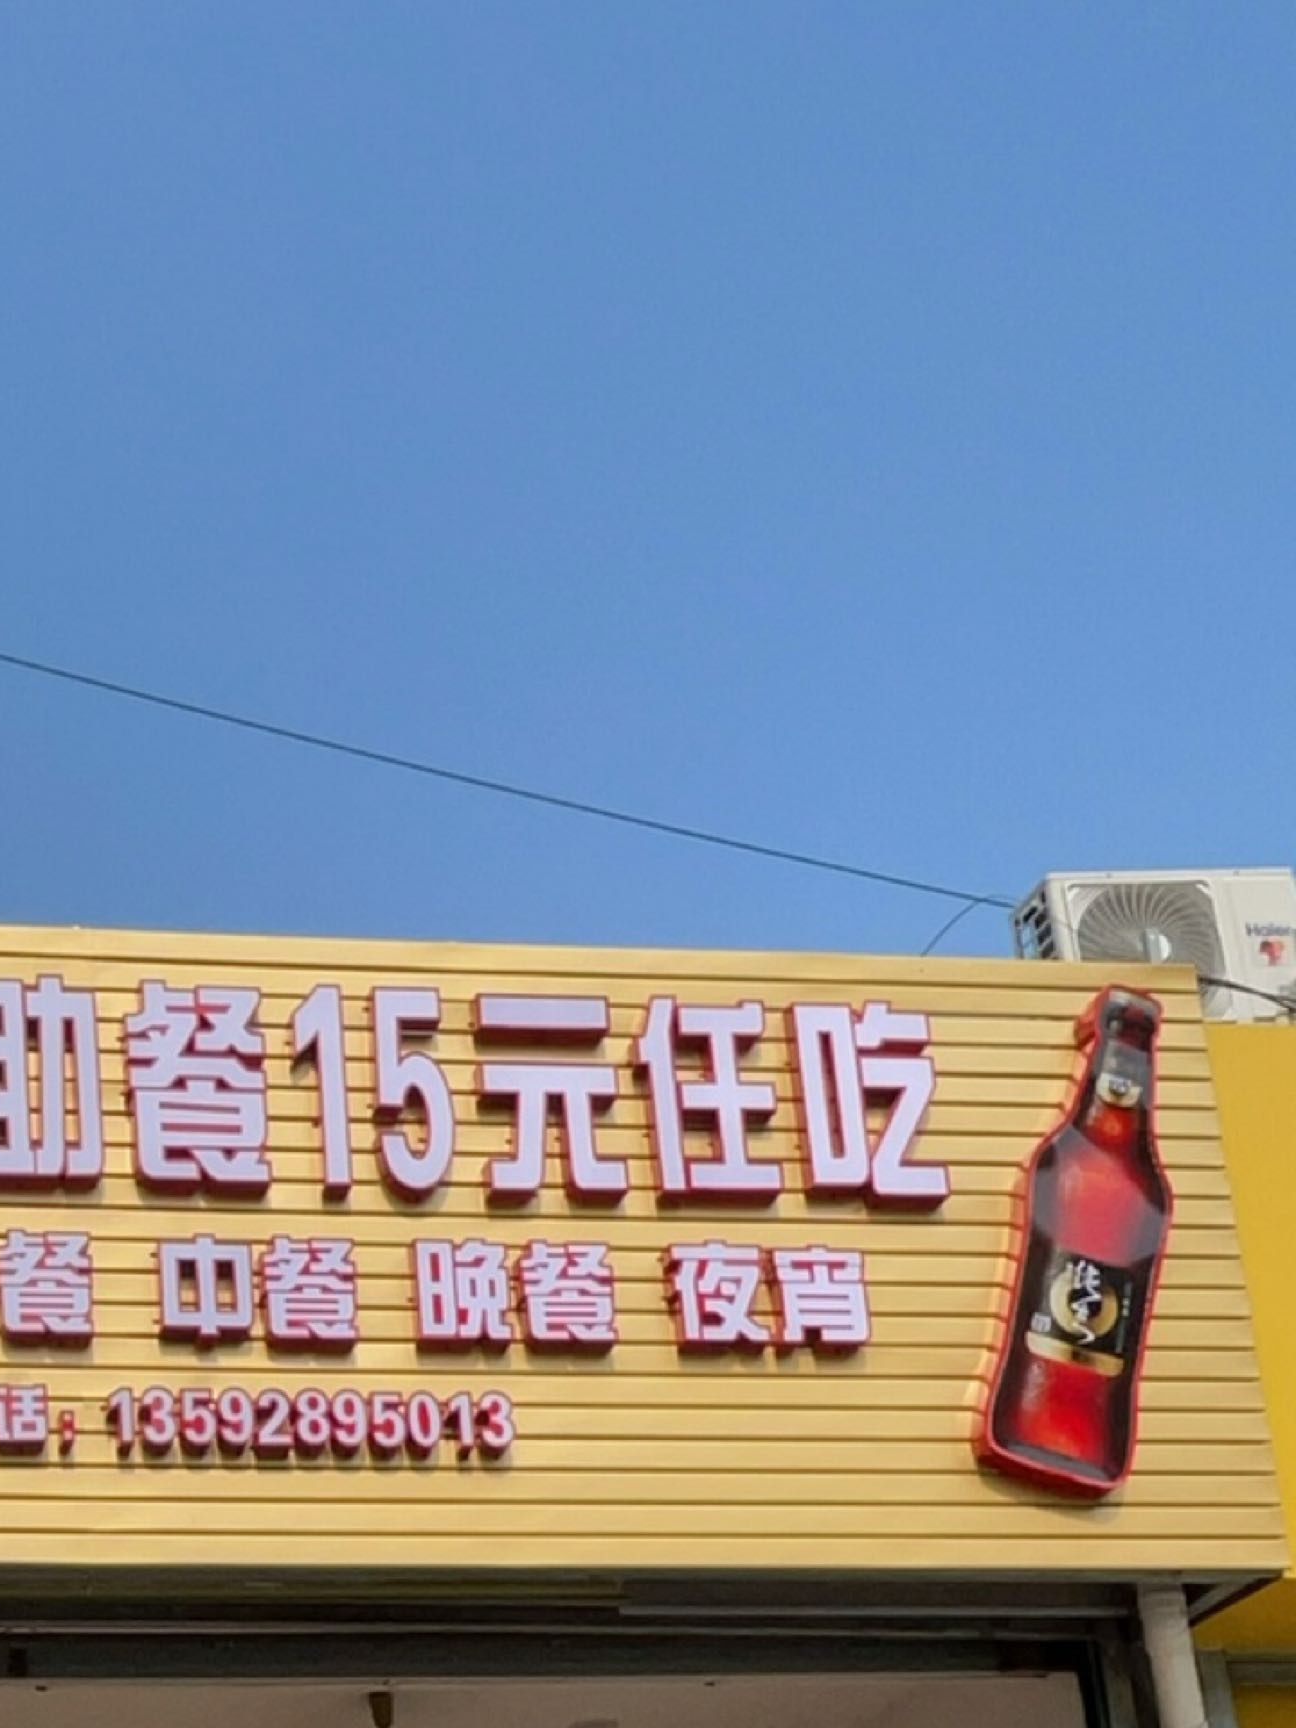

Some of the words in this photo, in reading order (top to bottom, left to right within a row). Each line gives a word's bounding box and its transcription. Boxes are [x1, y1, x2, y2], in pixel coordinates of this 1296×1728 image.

[157, 1234, 358, 1349] 中餐
[412, 1238, 616, 1351] 晚餐
[666, 1239, 871, 1352] 夜宵
